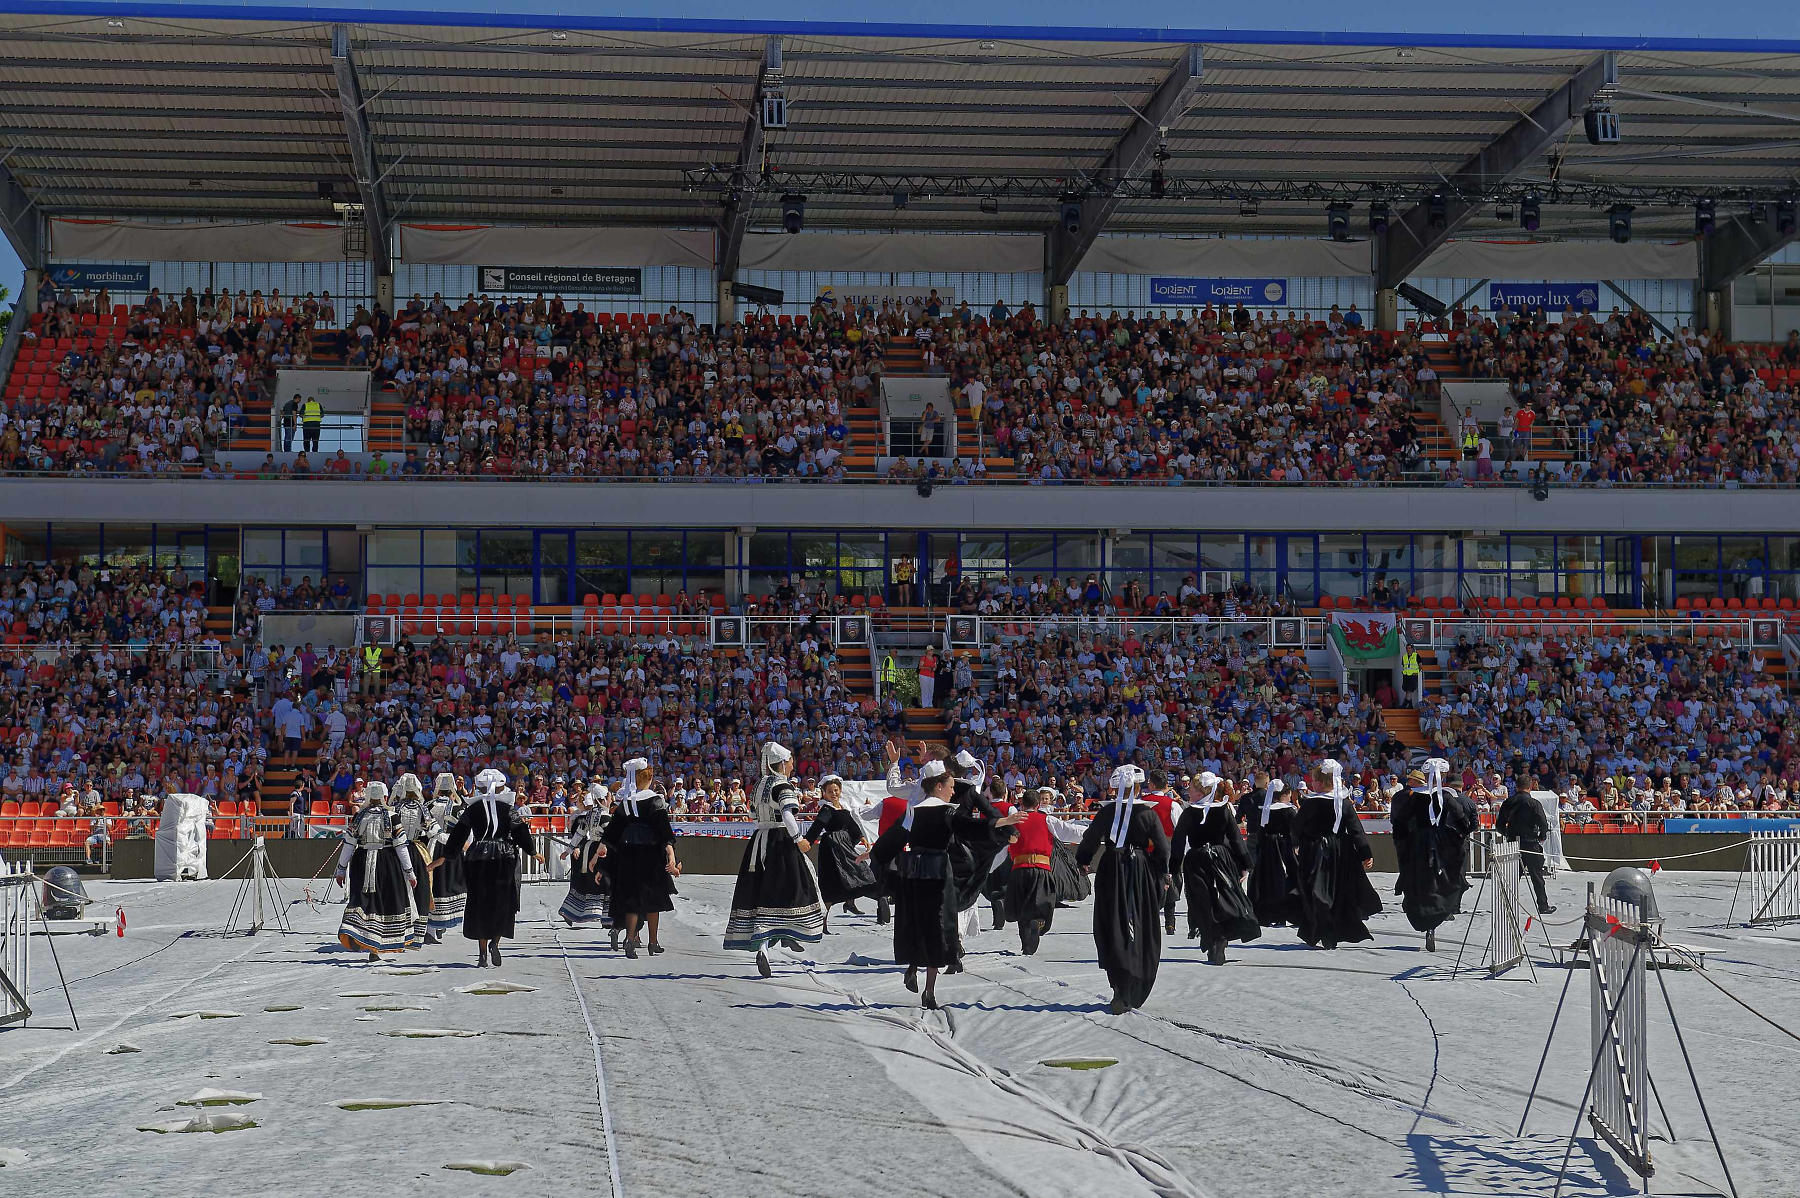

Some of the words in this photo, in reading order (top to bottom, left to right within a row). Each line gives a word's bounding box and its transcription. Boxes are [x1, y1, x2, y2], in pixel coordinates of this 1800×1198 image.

[86, 271, 144, 281] morbihan.fr
[509, 272, 541, 282] Conseil
[544, 272, 580, 284] régional
[582, 274, 593, 282] de
[596, 274, 635, 285] Bretagne
